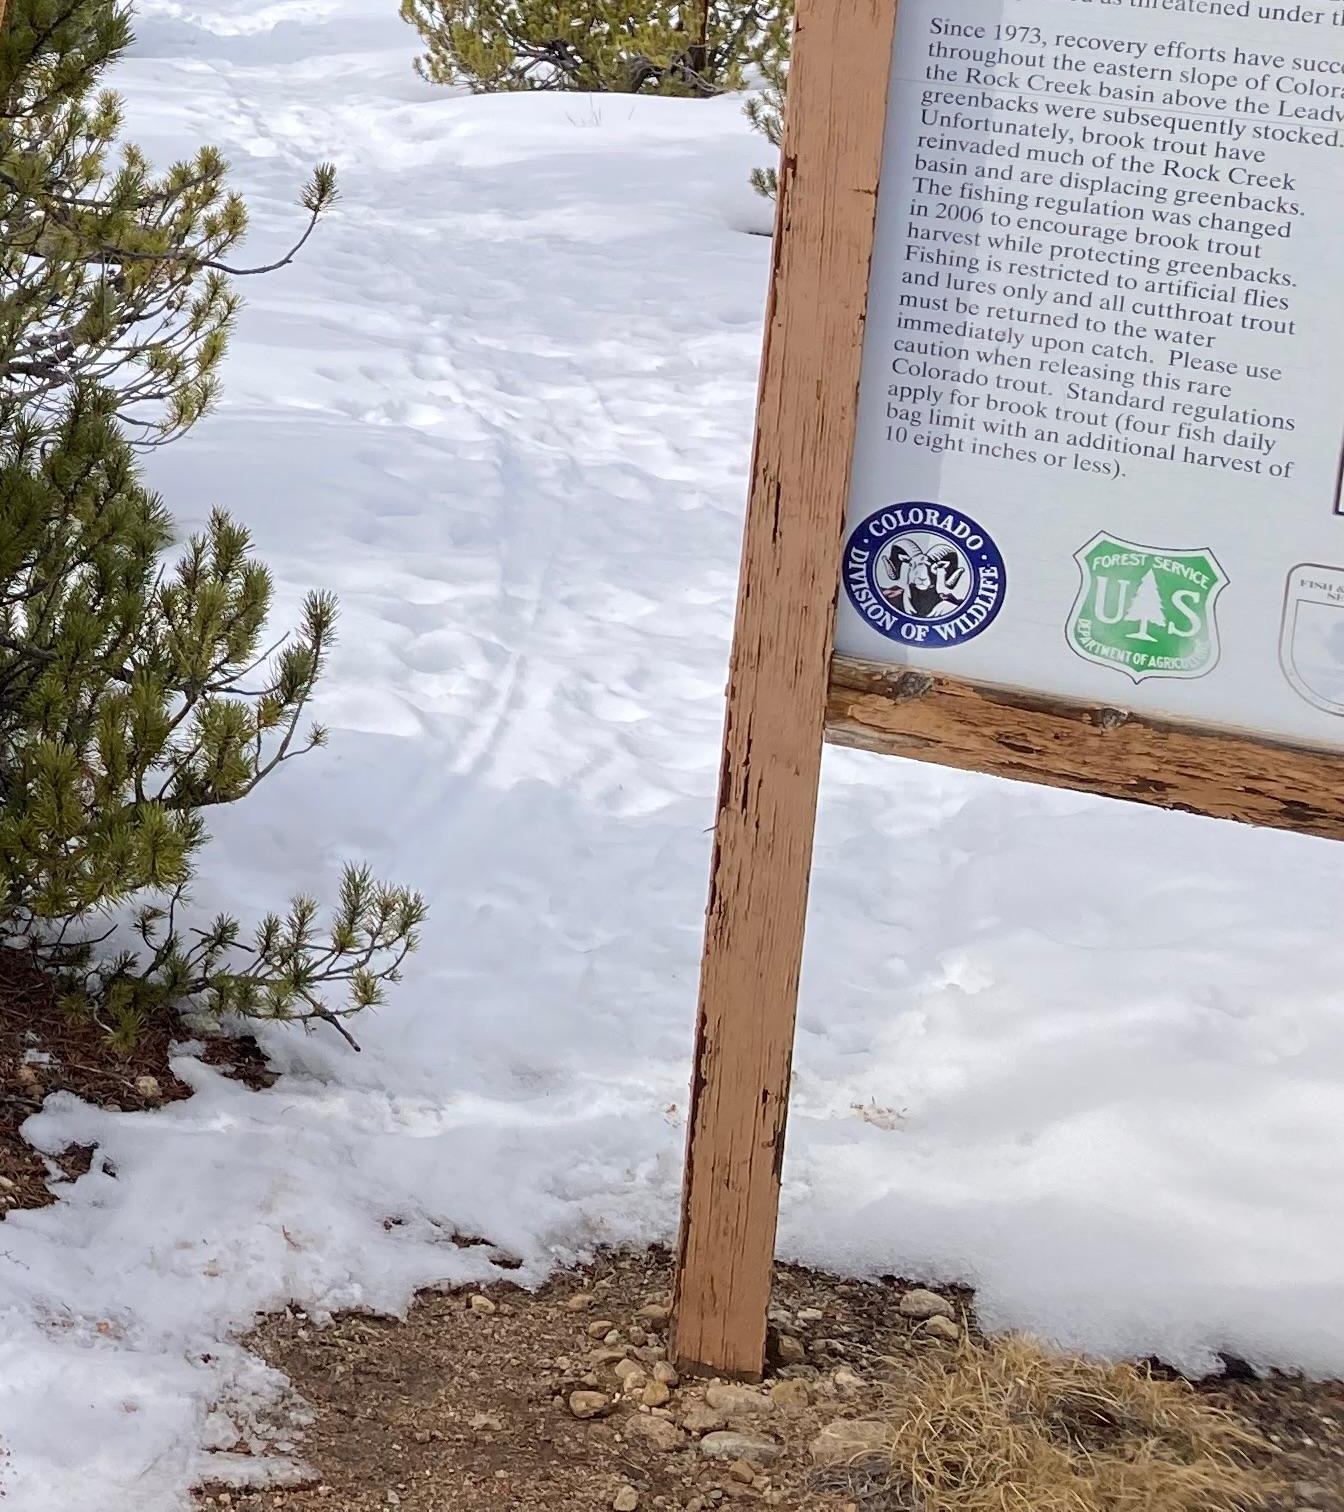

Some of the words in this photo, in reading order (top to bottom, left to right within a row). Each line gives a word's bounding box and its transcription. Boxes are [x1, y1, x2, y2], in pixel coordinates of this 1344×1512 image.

[1257, 3, 1326, 25] under
[927, 39, 1047, 69] throughout
[1051, 52, 1087, 73] the
[1092, 60, 1173, 82] eastern
[1177, 65, 1238, 92] slope
[1243, 72, 1272, 92] of
[928, 16, 986, 39] Since
[992, 23, 1048, 49] 1973,
[1053, 33, 1149, 59] recovery
[1152, 39, 1226, 63] efforts
[1231, 45, 1286, 69] have
[1290, 56, 1344, 75] succ
[919, 89, 1039, 115] greenbacks
[1043, 102, 1097, 121] were
[1101, 104, 1248, 141] subsequently
[1250, 119, 1344, 148] stocked.
[924, 62, 958, 82] the
[963, 65, 1021, 89] Rock
[1025, 72, 1095, 97] Creek
[1097, 79, 1155, 104] basin
[1160, 87, 1228, 111] above
[1233, 94, 1270, 115] the
[915, 131, 1021, 159] reinvaded
[1024, 147, 1085, 167] much
[1090, 151, 1117, 170] of
[1119, 153, 1155, 175] the
[1159, 157, 1222, 183] Rock
[1226, 165, 1297, 192] Creek
[920, 107, 1074, 145] Unfortunately,
[1080, 124, 1147, 150] brook
[1151, 134, 1209, 157] trout
[1212, 139, 1266, 163] have
[911, 175, 953, 197] The
[957, 180, 1030, 211] fishing
[1032, 195, 1145, 221] regulation
[1150, 208, 1192, 227] was
[1196, 210, 1292, 240] changed
[913, 152, 968, 176] basin
[973, 163, 1014, 181] and
[1018, 169, 1054, 186] are
[1058, 170, 1170, 205] displacing
[1171, 188, 1305, 217] greenbacks.
[905, 220, 982, 247] harvest
[986, 232, 1044, 255] while
[1047, 243, 1162, 275] protecting
[1163, 258, 1297, 288] greenbacks.
[908, 197, 929, 218] in
[933, 201, 984, 225] 2006
[989, 210, 1012, 228] to
[1015, 215, 1129, 245] encourage
[1133, 225, 1200, 252] brook
[1206, 236, 1263, 259] trout
[900, 269, 940, 288] and
[943, 271, 997, 296] lures
[1001, 281, 1049, 306] only
[1051, 289, 1094, 308] and
[1097, 293, 1125, 313] all
[1130, 301, 1235, 327] cutthroat
[1239, 312, 1296, 336] trout
[902, 243, 981, 274] Fishing
[984, 253, 1002, 273] is
[1006, 261, 1110, 287] restricted
[1115, 272, 1138, 290] to
[1143, 277, 1237, 304] artificial
[1241, 287, 1289, 311] flies
[895, 310, 1025, 349] immediately
[1030, 334, 1085, 354] upon
[1090, 342, 1154, 364] catch.
[1166, 348, 1238, 375] Please
[1245, 363, 1282, 381] use
[897, 293, 949, 312] must
[954, 294, 980, 316] be
[985, 304, 1079, 329] returned
[1084, 315, 1107, 334] to
[1112, 318, 1148, 339] the
[1152, 327, 1217, 349] water
[890, 356, 989, 387] Colorado
[994, 373, 1053, 396] trout.
[1065, 381, 1165, 413] Standard
[1169, 401, 1296, 432] regulations
[892, 338, 969, 361] caution
[974, 345, 1032, 370] when
[1036, 356, 1137, 389] releasing
[1141, 369, 1181, 391] this
[1185, 379, 1232, 398] rare
[885, 400, 922, 427] bag
[927, 406, 977, 431] limit
[980, 417, 1028, 439] with
[1032, 427, 1060, 444] an
[1064, 430, 1176, 461] additional
[1180, 444, 1263, 475] harvest
[1267, 460, 1295, 479] of
[886, 383, 944, 407] apply
[947, 387, 981, 409] for
[984, 392, 1048, 419] brook
[1054, 405, 1109, 428] trout
[1113, 410, 1172, 437] (four
[1175, 420, 1215, 444] fish
[1221, 427, 1277, 457] daily
[886, 424, 908, 444] 10
[912, 429, 965, 454] eight
[970, 436, 1037, 464] inches
[1042, 452, 1068, 468] or
[1071, 451, 1126, 481] less).
[868, 507, 984, 550] COLORADO
[848, 546, 898, 631] DIVISION
[900, 623, 929, 641] OF
[932, 566, 999, 641] WILDLIFE
[1092, 553, 1148, 571] FOREST
[1152, 556, 1210, 589] SERVICE
[1077, 618, 1132, 663] DEPARTMENT
[1133, 652, 1148, 665] OF
